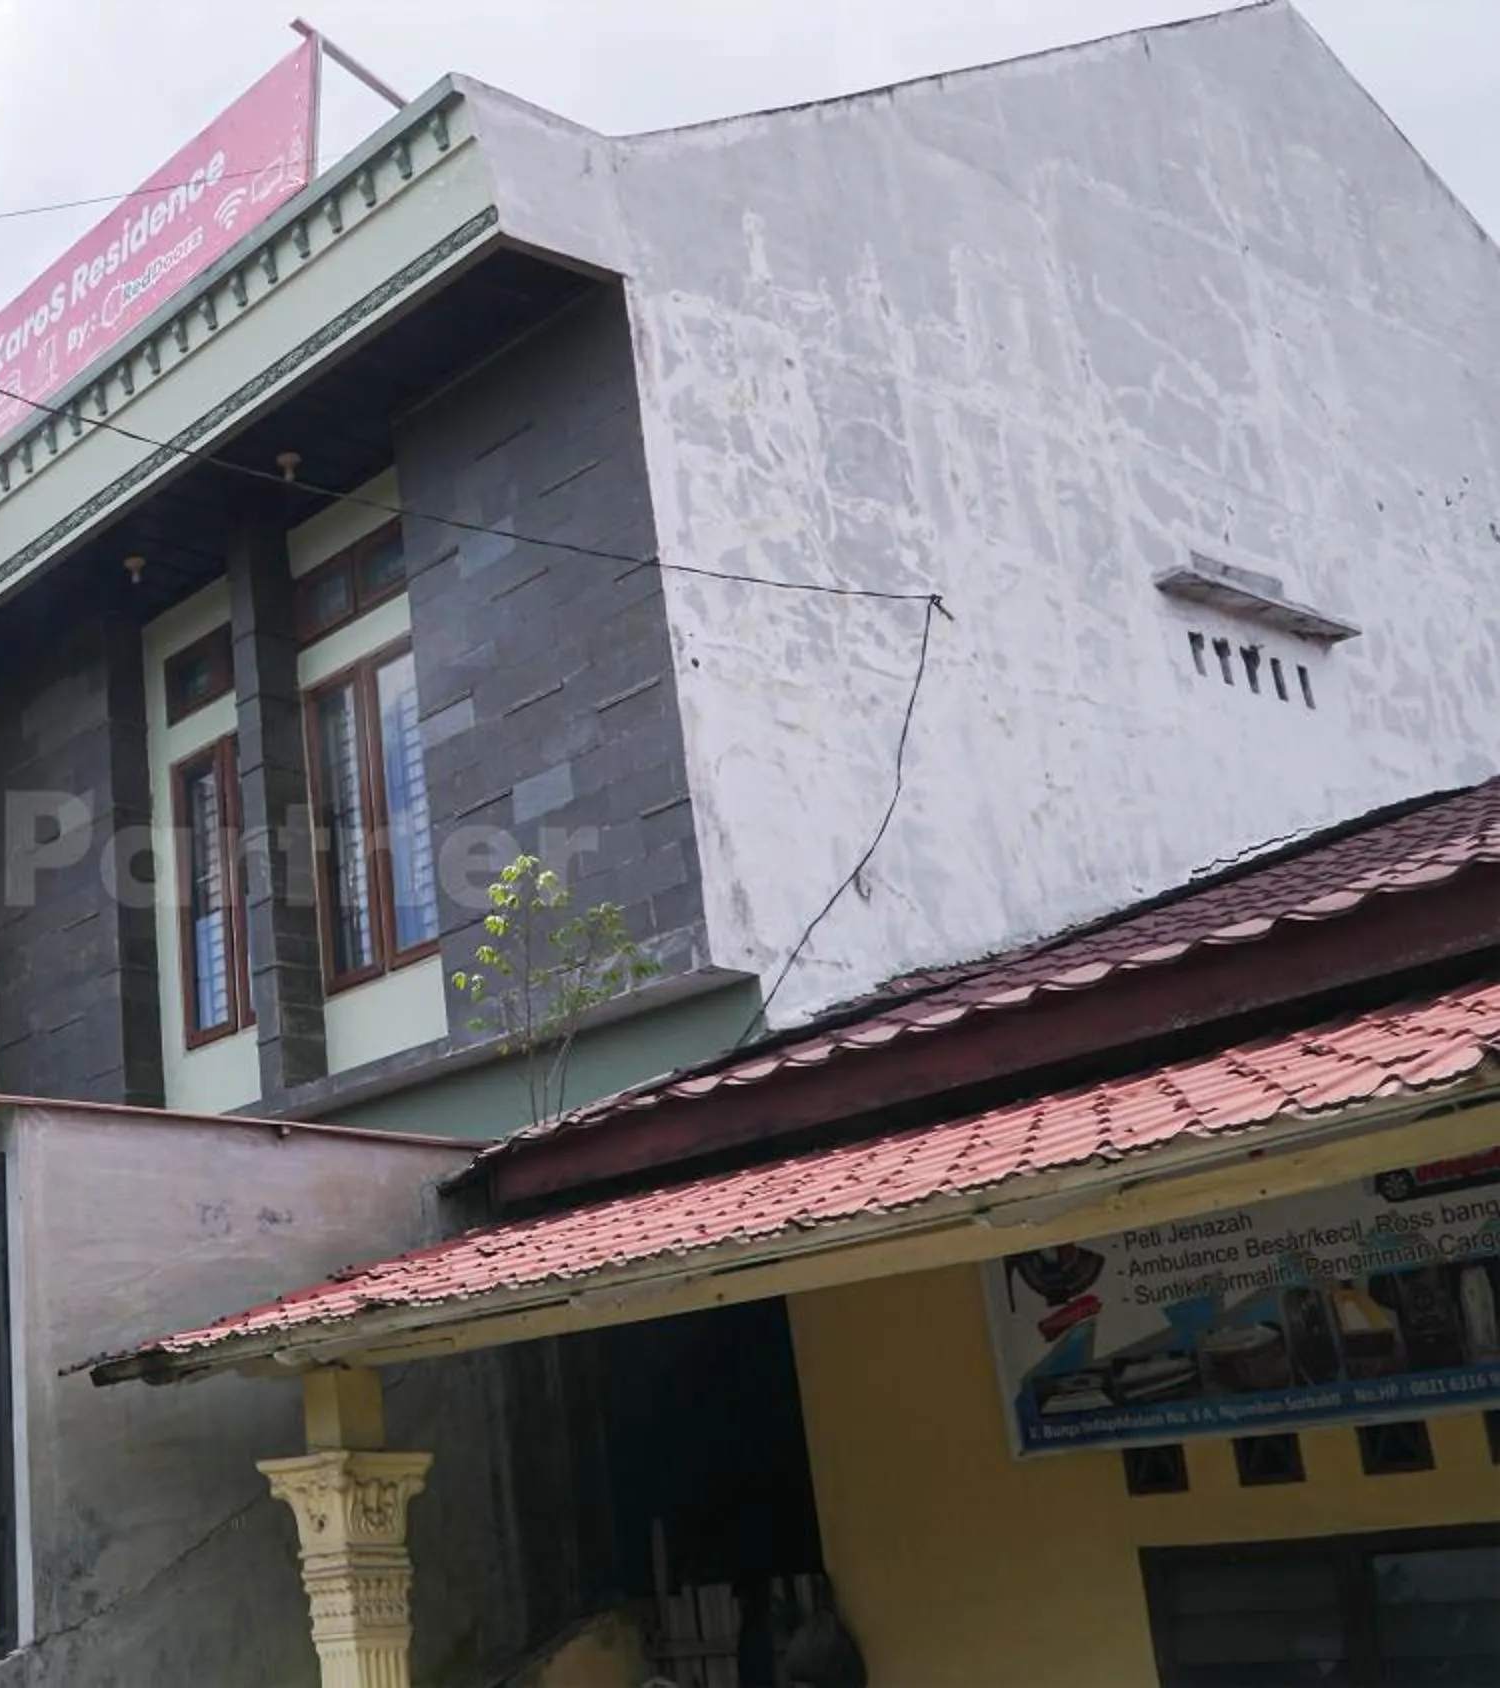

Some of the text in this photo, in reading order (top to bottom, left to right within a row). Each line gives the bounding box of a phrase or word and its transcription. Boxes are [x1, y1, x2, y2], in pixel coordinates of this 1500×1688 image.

[70, 150, 226, 307] Residence
[1123, 1212, 1253, 1250] Peti Jenazah
[1129, 1246, 1240, 1277] Ambulance
